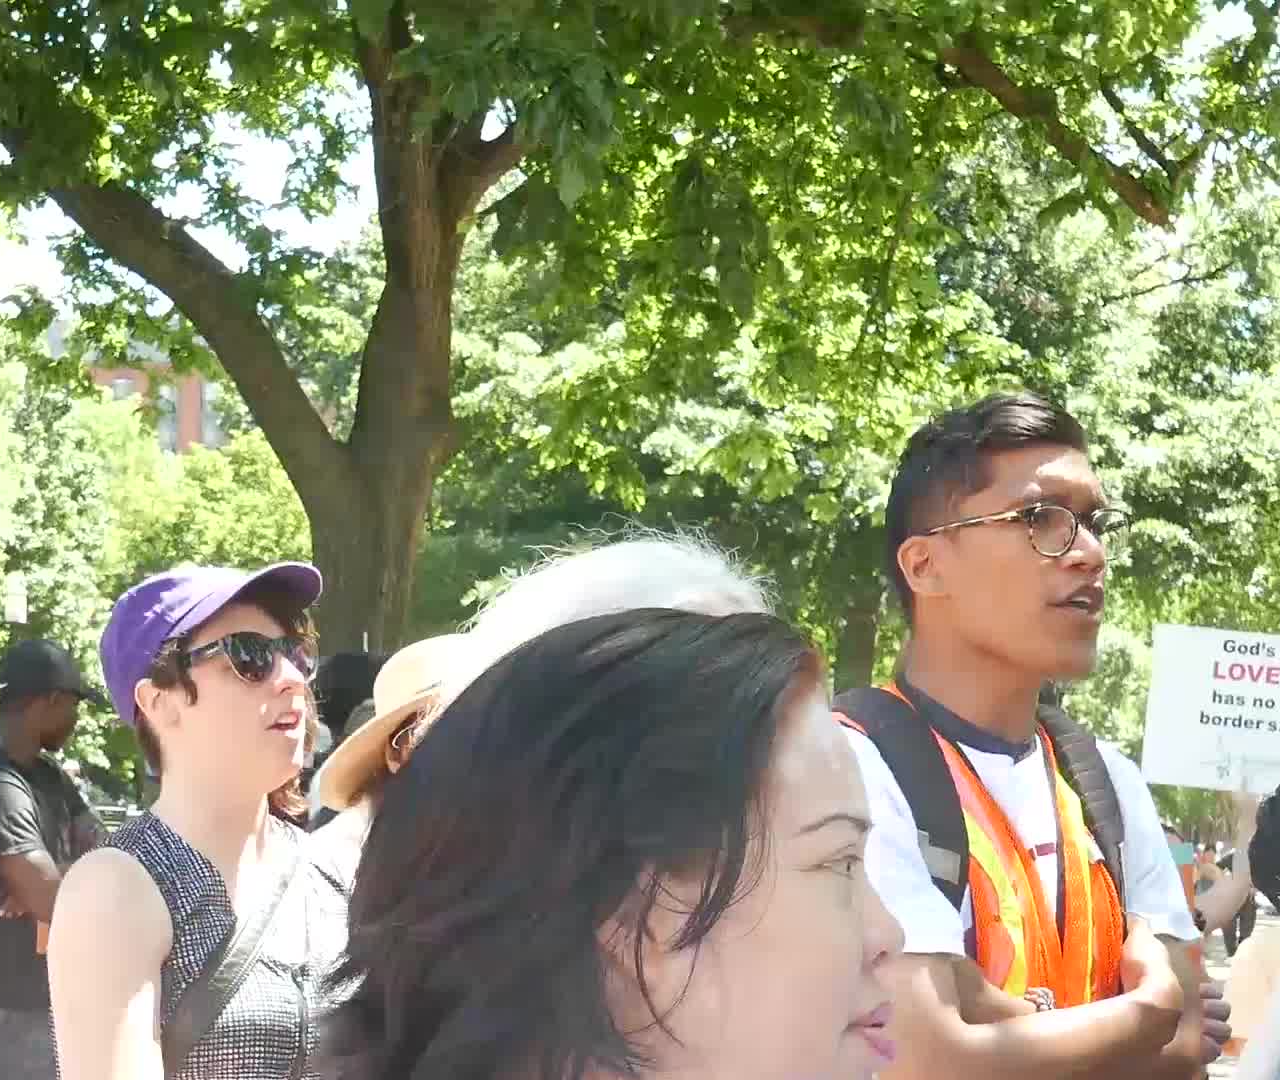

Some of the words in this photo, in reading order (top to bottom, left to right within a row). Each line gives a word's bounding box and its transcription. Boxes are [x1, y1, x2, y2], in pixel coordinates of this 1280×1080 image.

[1223, 639, 1276, 657] God's
[1213, 661, 1280, 684] LOVE
[1212, 690, 1246, 705] has
[1252, 697, 1276, 709] no
